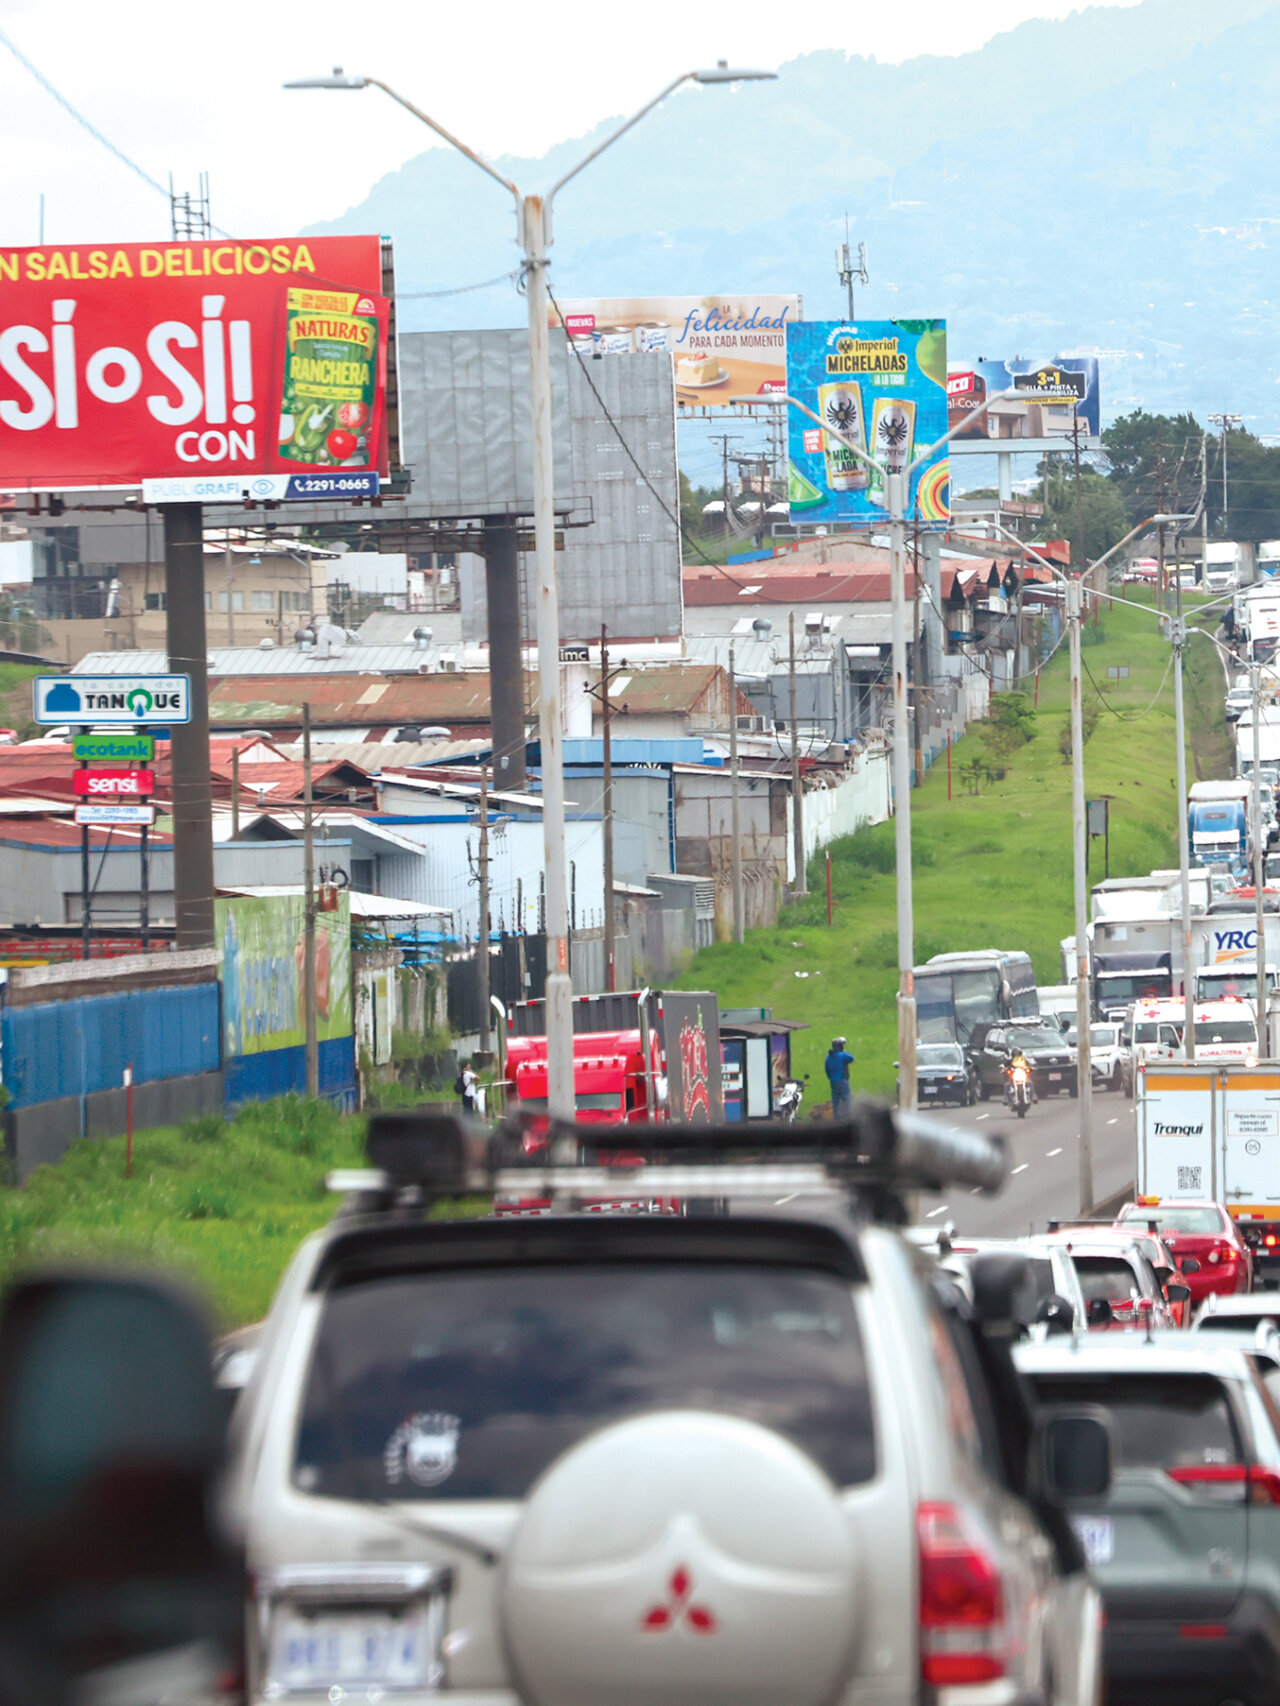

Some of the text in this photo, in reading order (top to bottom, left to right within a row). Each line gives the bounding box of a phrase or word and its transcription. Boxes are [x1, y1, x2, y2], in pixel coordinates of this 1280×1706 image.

[0, 244, 316, 281] N SALSA DELICIOSA
[722, 305, 731, 314] LA
[567, 317, 593, 328] NUEVAS
[676, 306, 789, 343] felicidad
[689, 335, 784, 348] PARA CADA MOMENTO
[855, 339, 897, 353] Imperial
[0, 299, 79, 430] SÍ
[147, 294, 255, 425] SÍ!
[828, 355, 906, 372] MICHELADAS
[290, 356, 370, 385] RANCHERA
[947, 377, 969, 393] NCO
[1037, 372, 1047, 385] 3
[1054, 372, 1060, 384] 1
[175, 430, 255, 462] CON
[836, 460, 858, 472] LADA
[305, 479, 370, 491] 2291-0665
[560, 649, 586, 660] imc
[85, 688, 180, 717] TANQUE
[75, 741, 149, 756] ecotank
[88, 772, 139, 793] sensi
[1214, 929, 1257, 950] YRC
[1153, 1122, 1204, 1137] Tranqui
